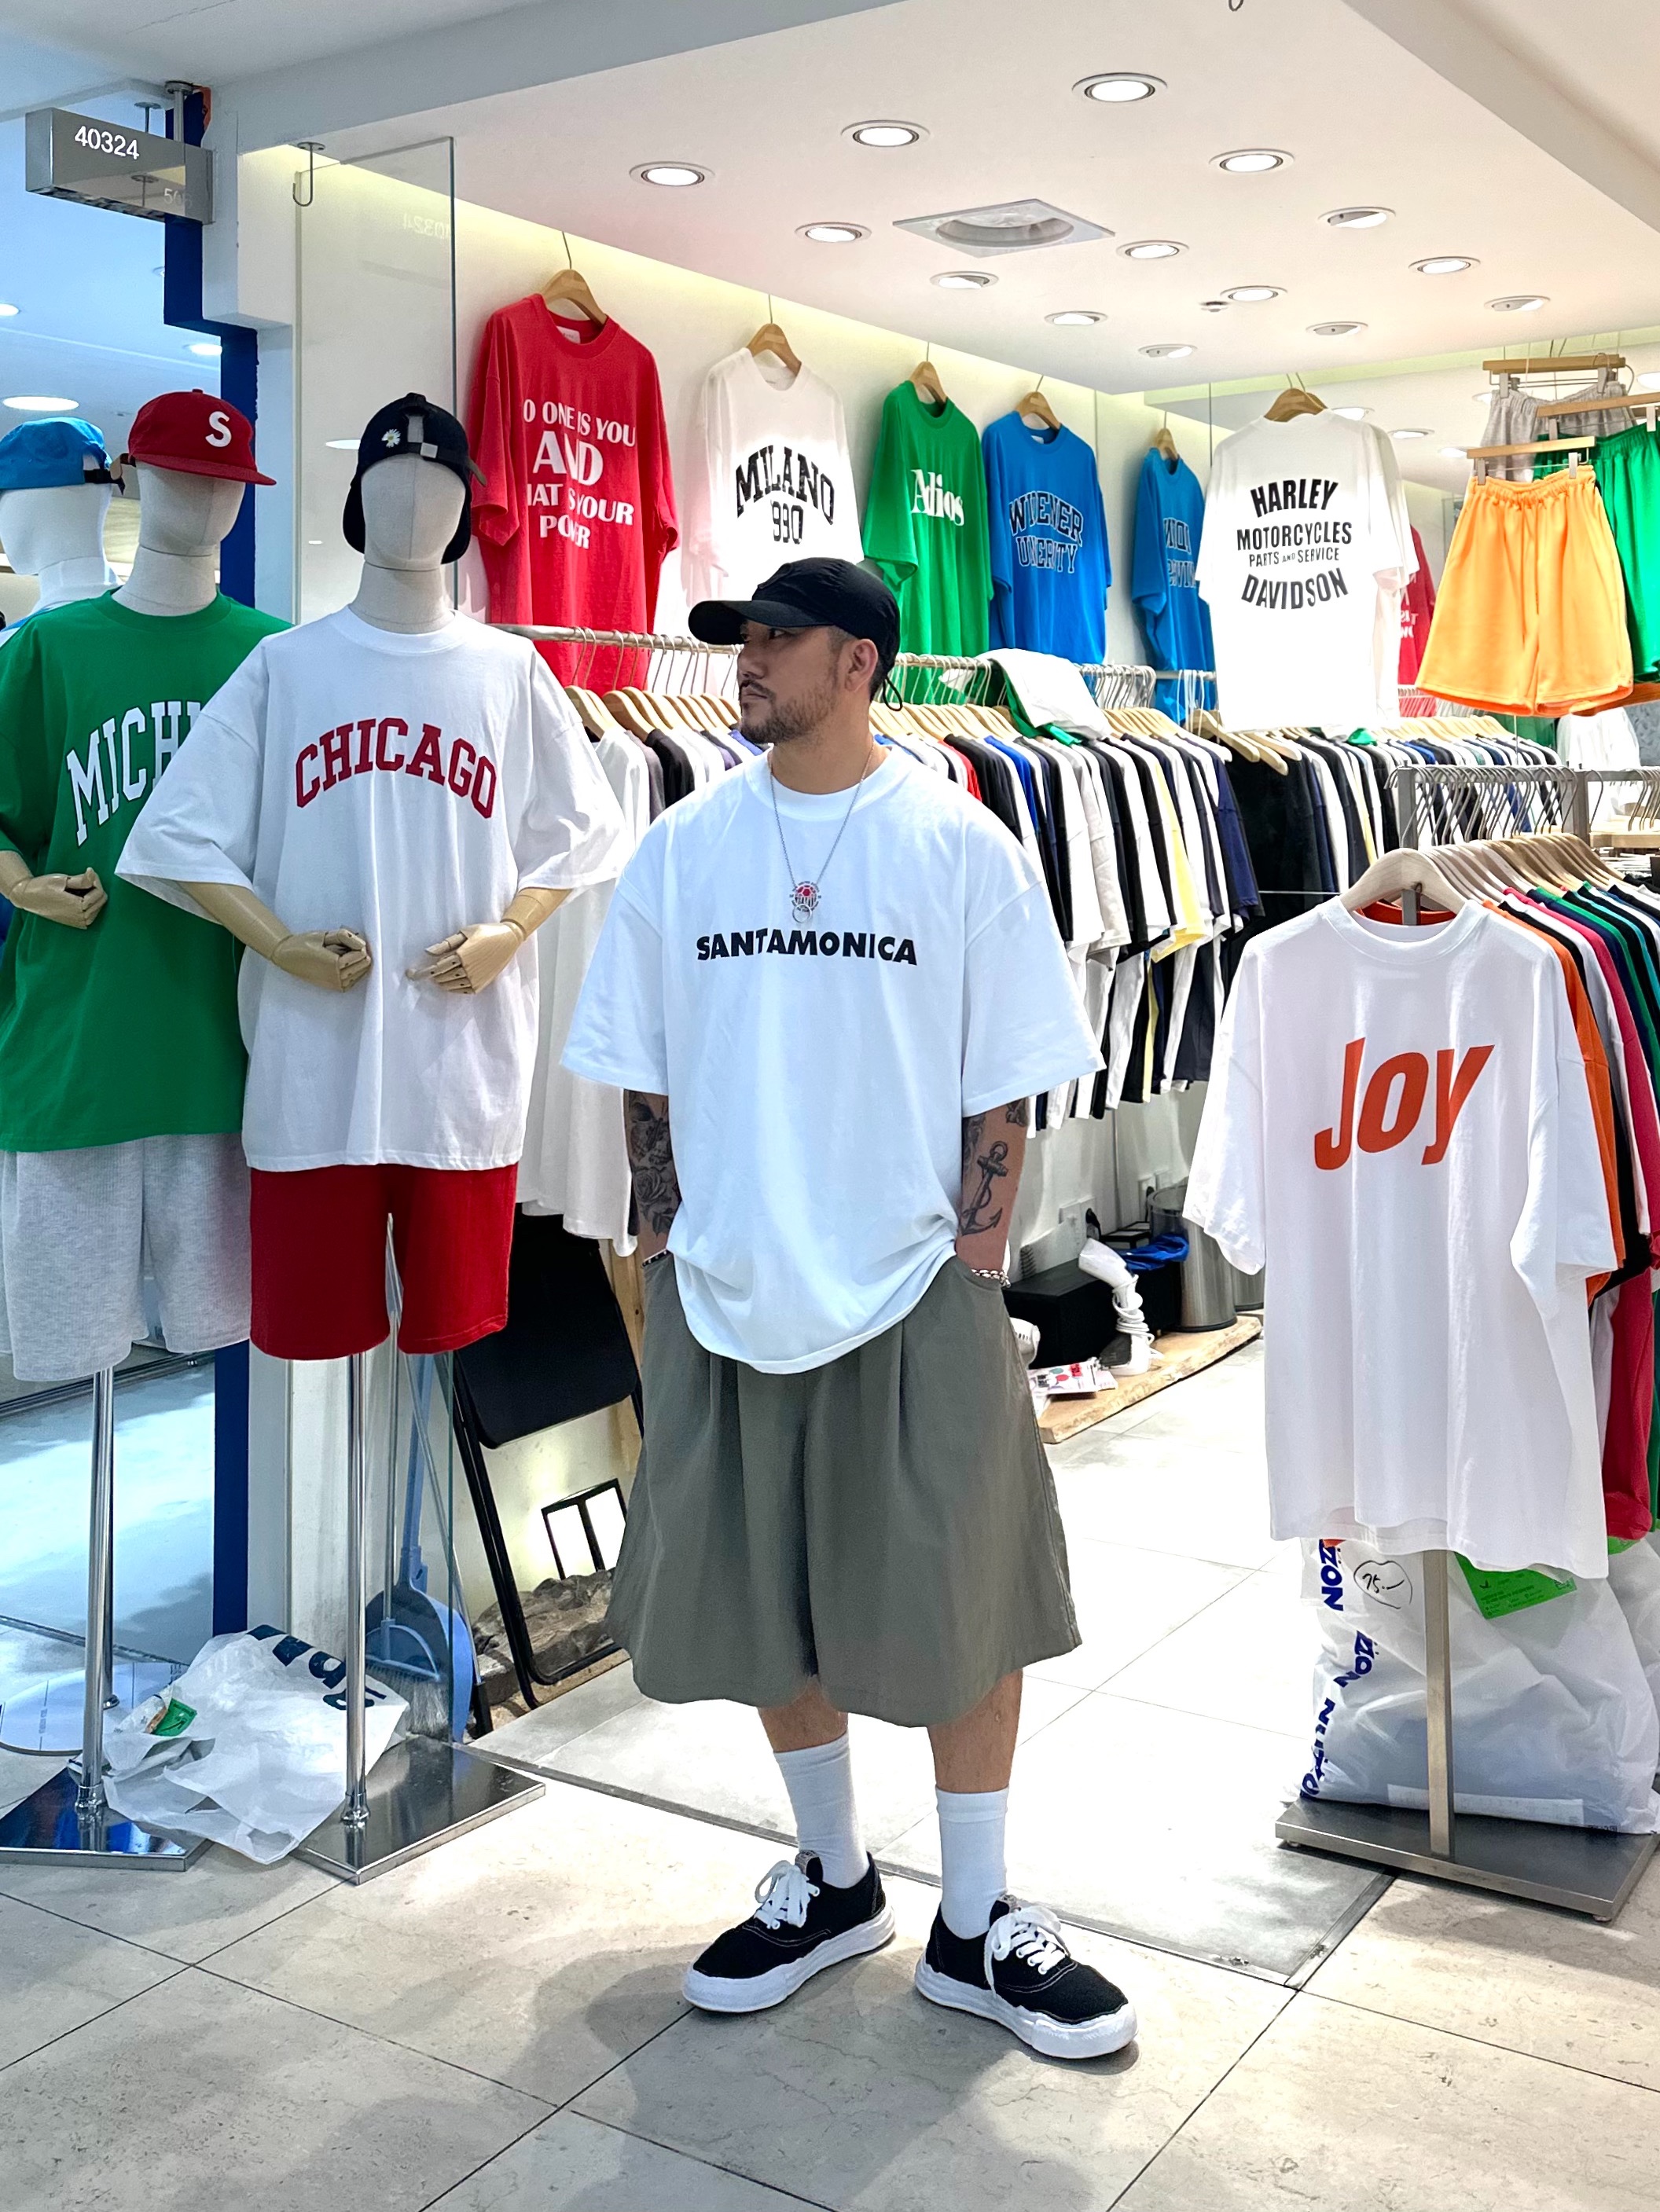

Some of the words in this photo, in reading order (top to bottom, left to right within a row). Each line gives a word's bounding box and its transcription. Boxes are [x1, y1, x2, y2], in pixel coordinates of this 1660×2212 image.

[75, 126, 139, 160] 40324
[205, 411, 232, 448] S
[542, 401, 575, 430] ONE
[596, 417, 636, 447] YOU
[532, 430, 604, 486] AND
[735, 445, 835, 526] MILANO
[1250, 479, 1339, 518] HARLEY
[1236, 521, 1352, 551] MOTORCYCLES
[1248, 551, 1280, 567] PARTS
[1298, 546, 1339, 563] SERVICE
[1240, 567, 1349, 610] DAVIDSON
[296, 717, 497, 819] CHICAGO
[696, 927, 918, 966] SANTAMONICA
